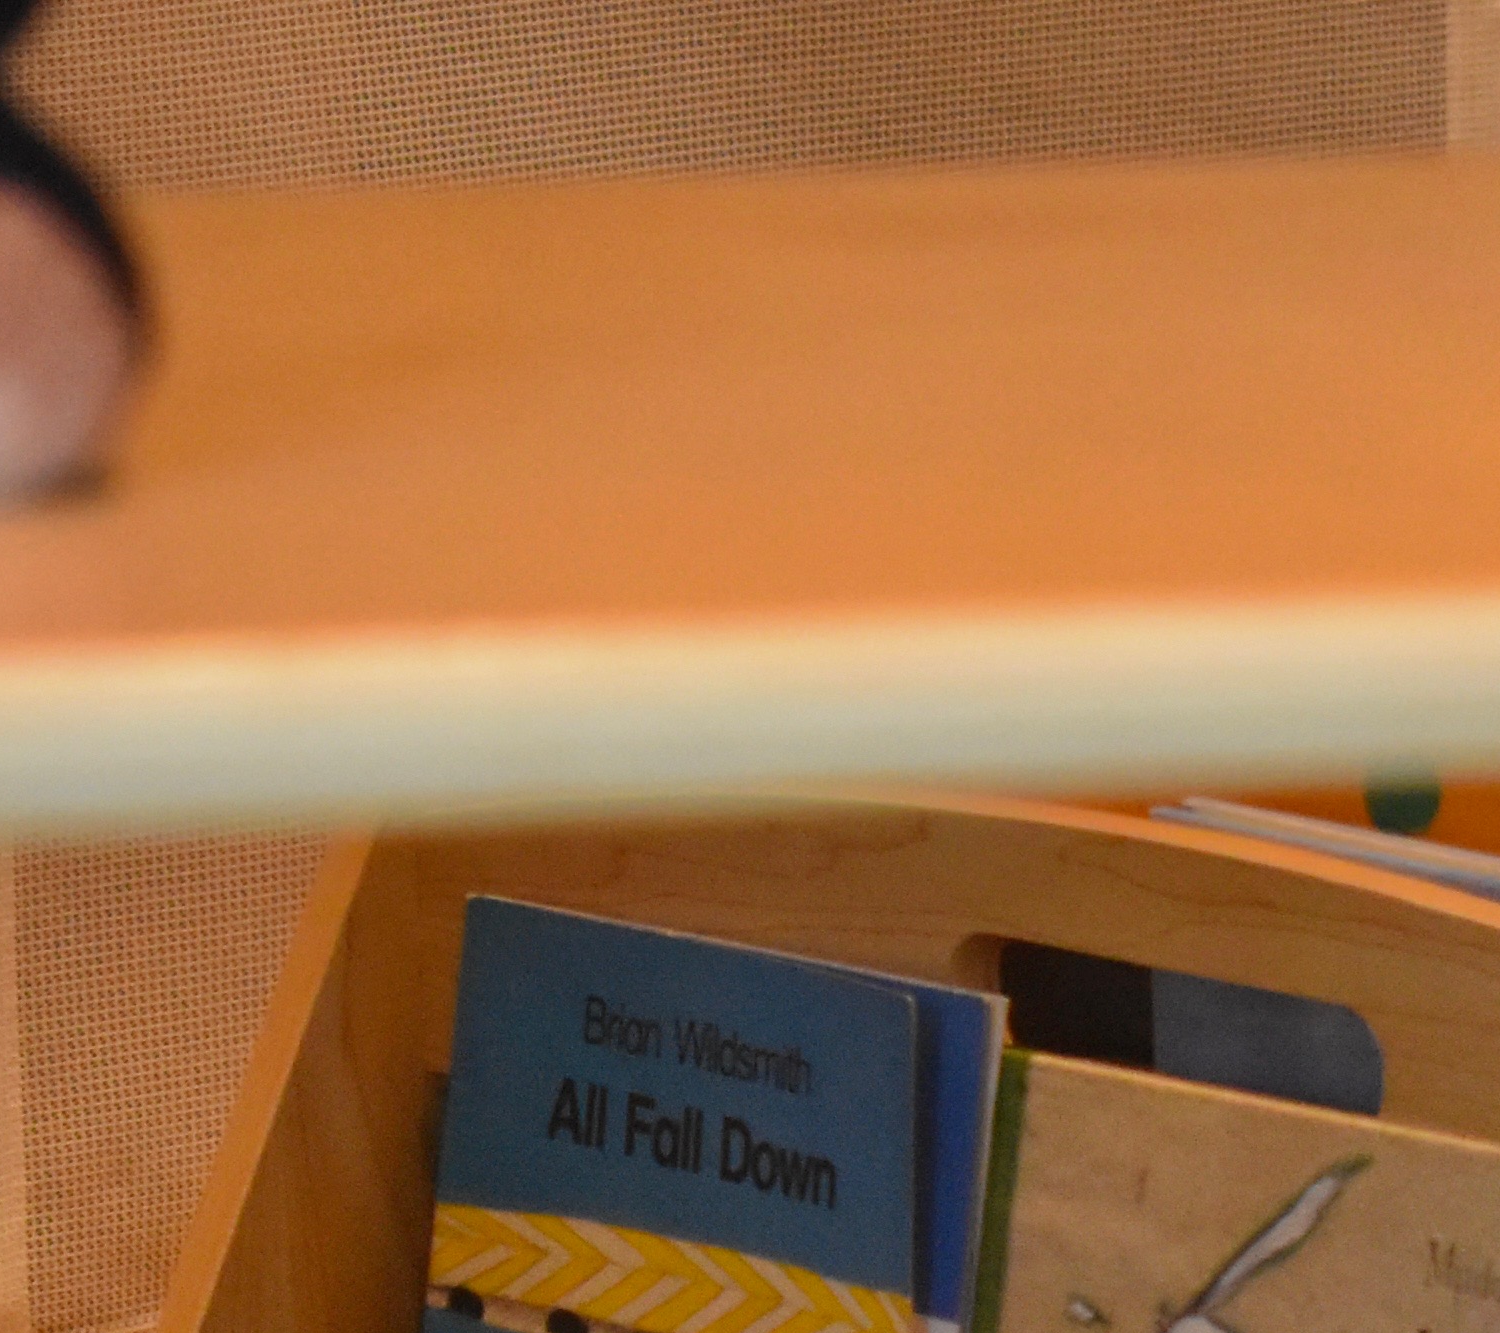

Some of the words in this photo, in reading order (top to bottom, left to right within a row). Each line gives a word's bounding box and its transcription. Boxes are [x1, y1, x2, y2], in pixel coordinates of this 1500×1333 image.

[583, 994, 662, 1060] Brian
[674, 1017, 812, 1095] Wildsmith
[548, 1078, 608, 1150] All
[624, 1092, 702, 1176] Fall
[718, 1114, 837, 1211] Down
